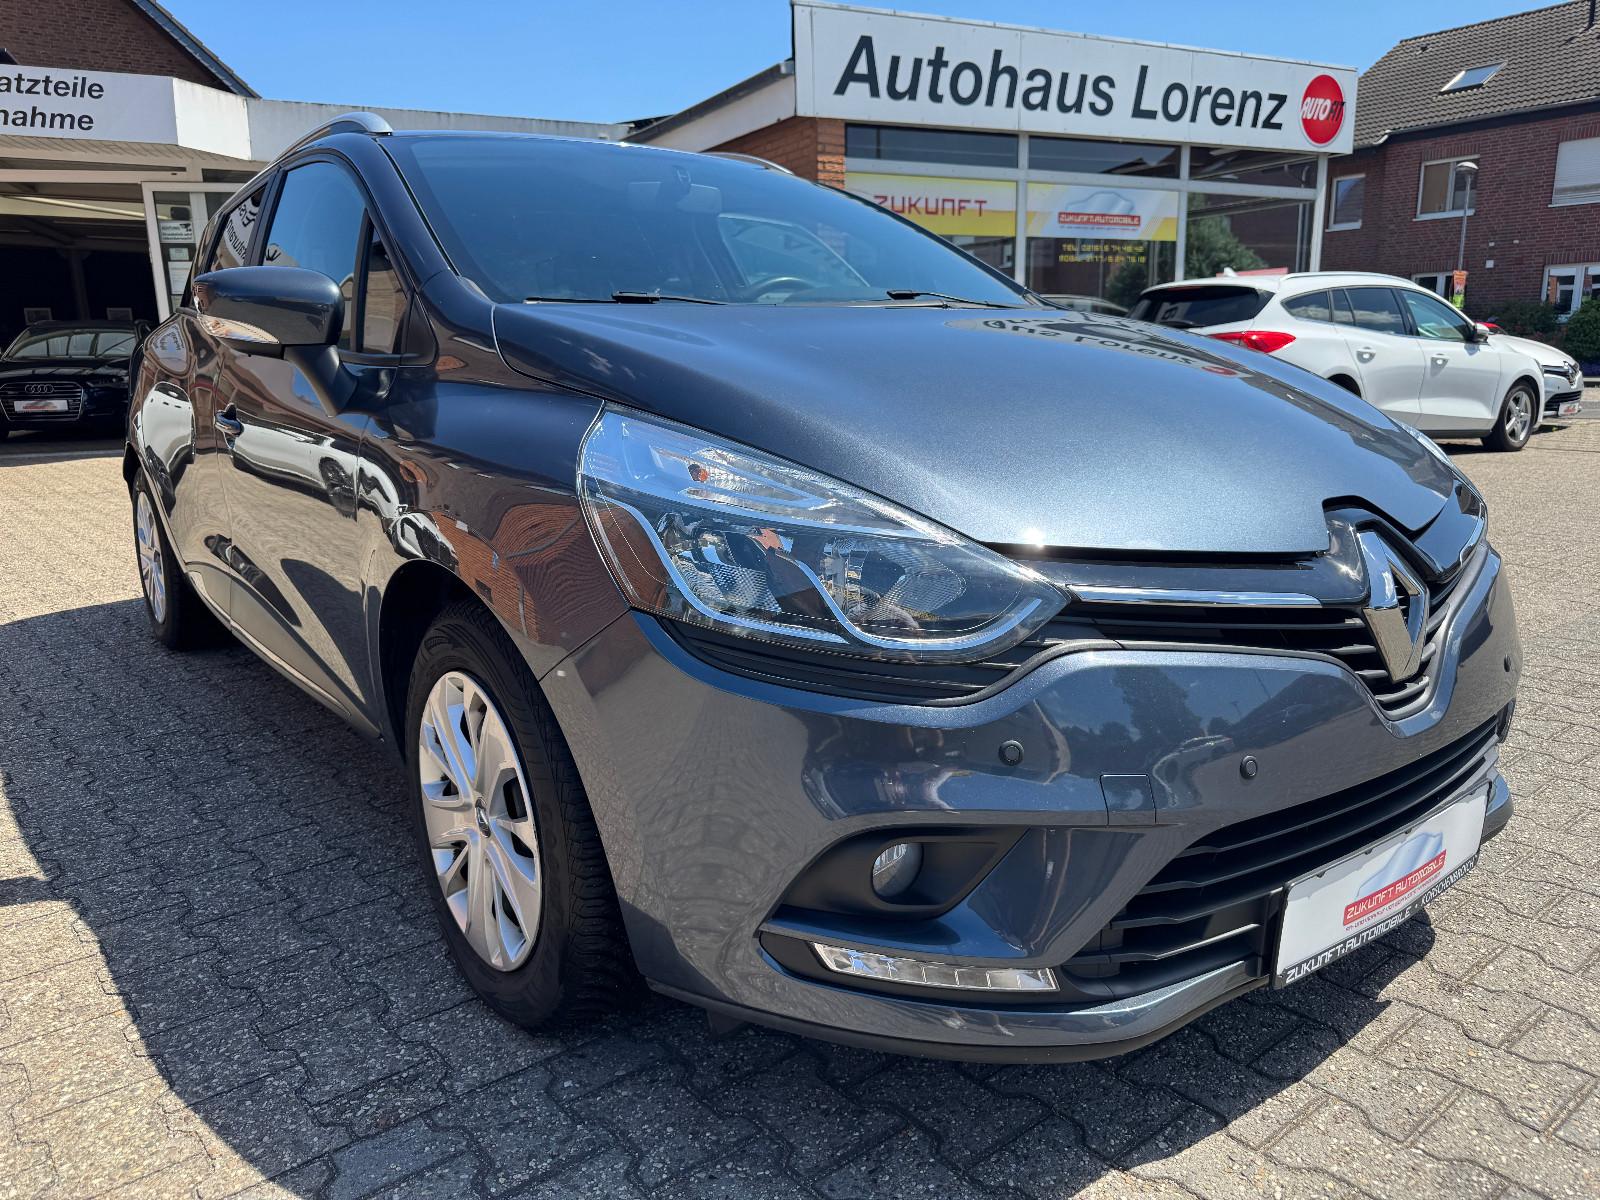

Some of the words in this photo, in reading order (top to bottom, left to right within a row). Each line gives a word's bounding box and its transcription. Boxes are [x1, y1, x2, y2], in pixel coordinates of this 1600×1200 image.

[834, 35, 1115, 117] Autohaus
[1131, 65, 1288, 131] Lorenz
[1300, 96, 1346, 122] AUTOFIT
[873, 195, 987, 217] ZUKUNFT
